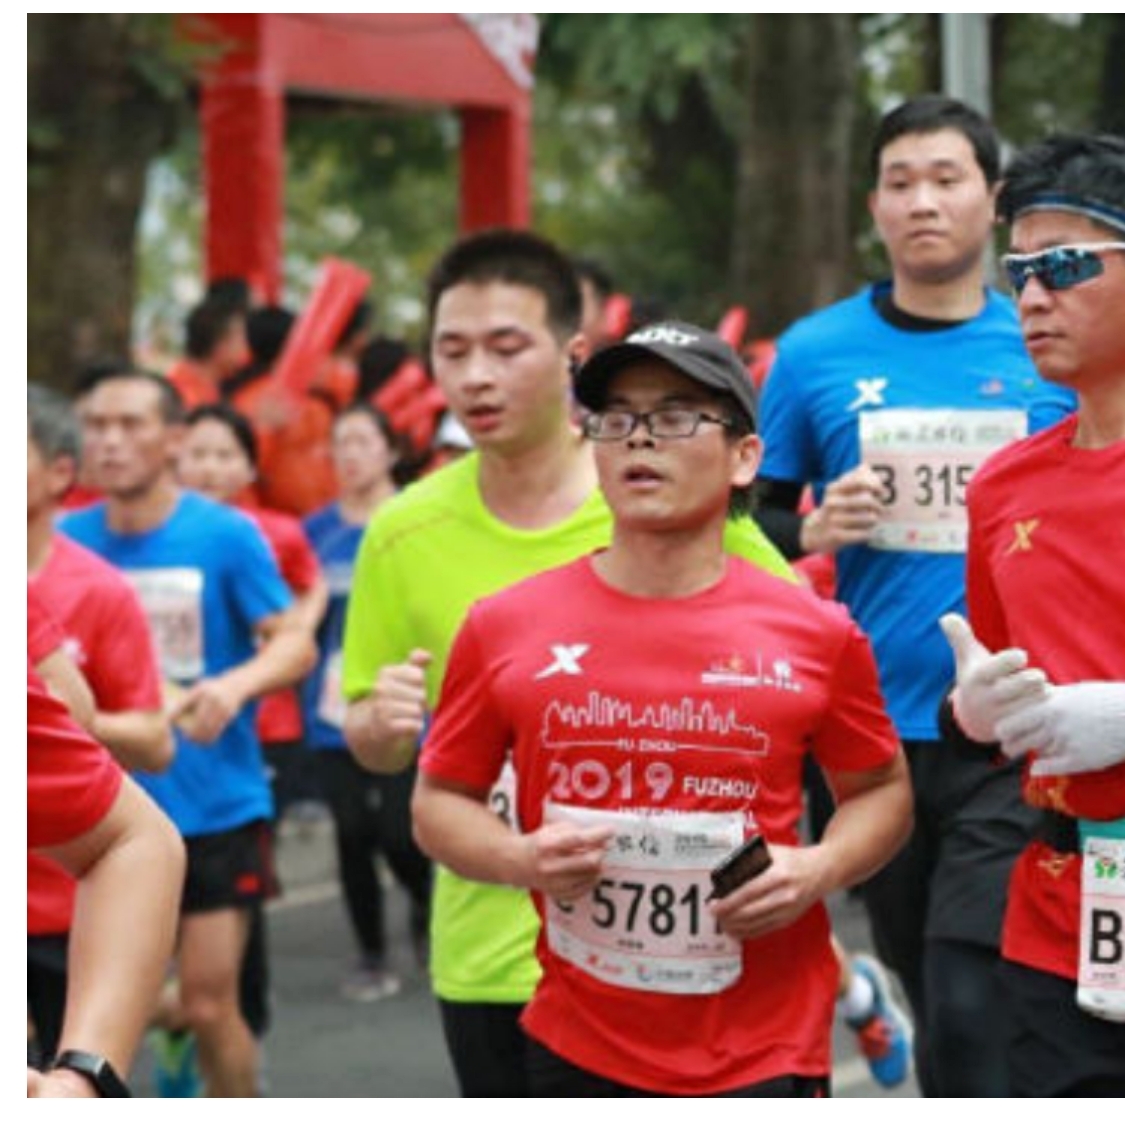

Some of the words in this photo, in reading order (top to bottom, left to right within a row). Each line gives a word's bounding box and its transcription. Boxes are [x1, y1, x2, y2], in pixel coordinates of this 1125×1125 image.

[549, 759, 674, 801] 2019
[684, 776, 757, 798] FUZHOU
[1090, 908, 1123, 965] B
